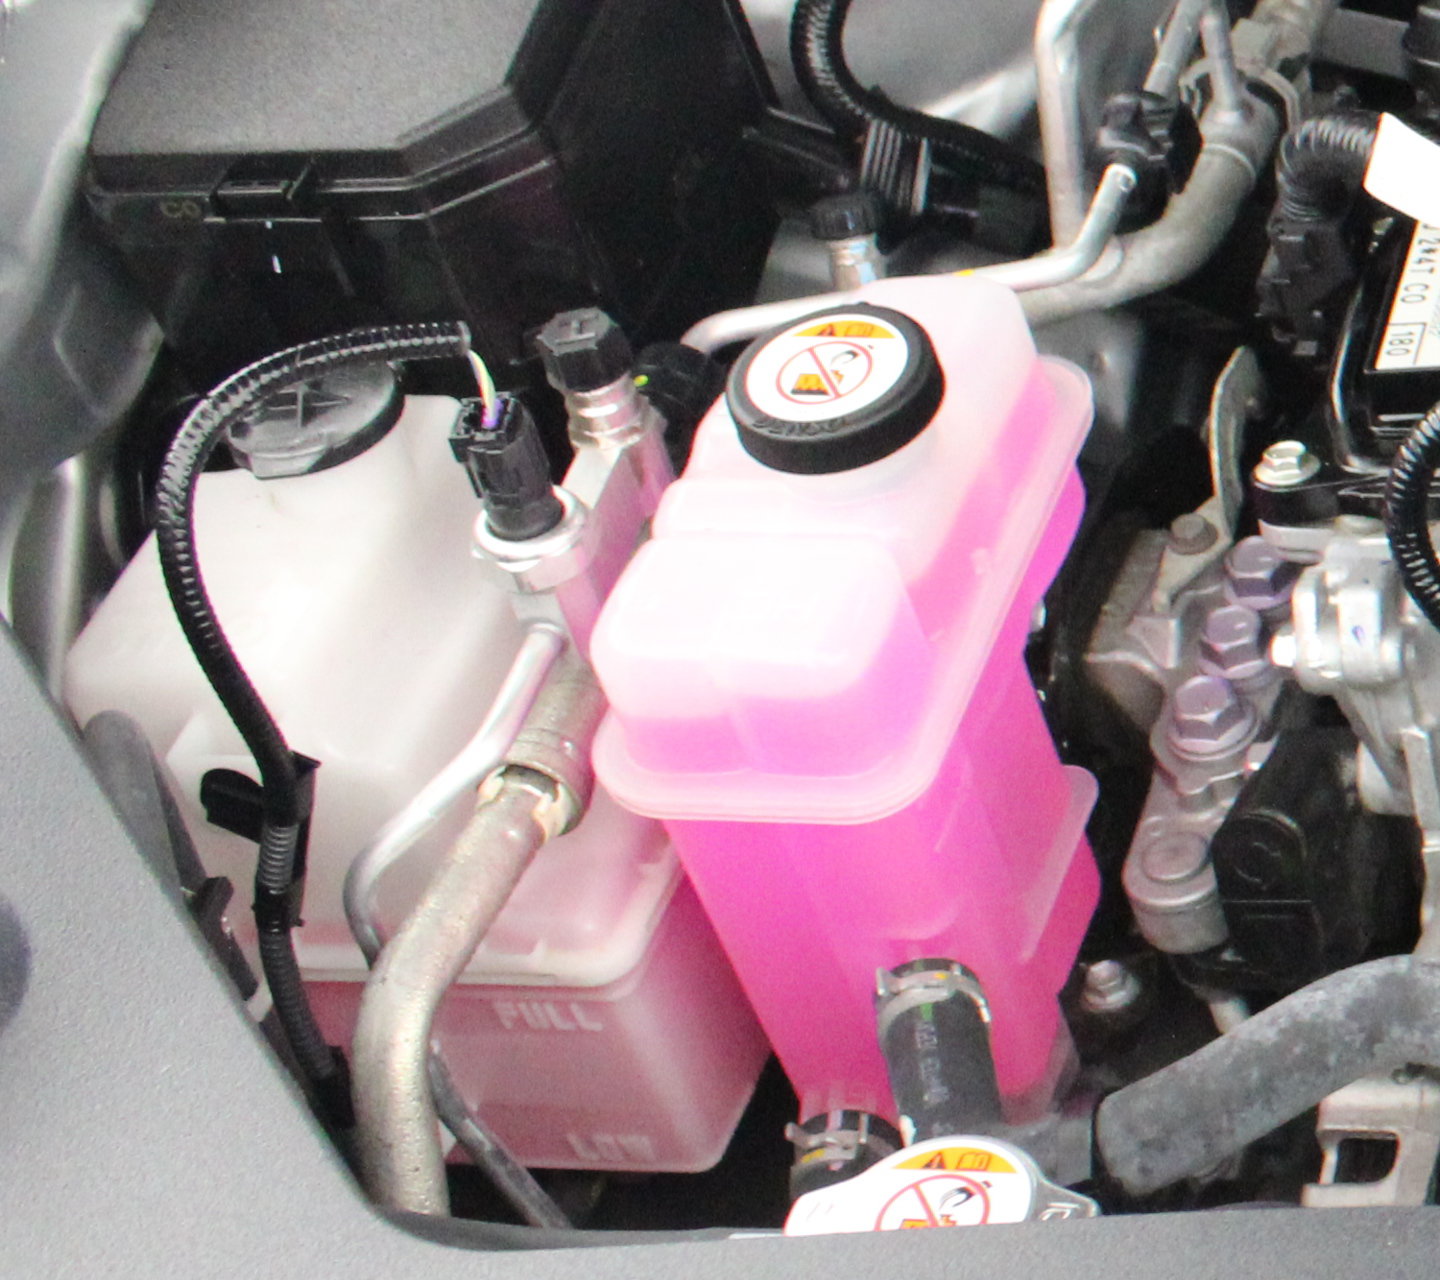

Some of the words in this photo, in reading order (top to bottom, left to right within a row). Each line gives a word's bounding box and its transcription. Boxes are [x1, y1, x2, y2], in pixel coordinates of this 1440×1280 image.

[1384, 331, 1415, 357] 180
[492, 999, 605, 1033] FULL
[566, 1131, 657, 1162] LOW
